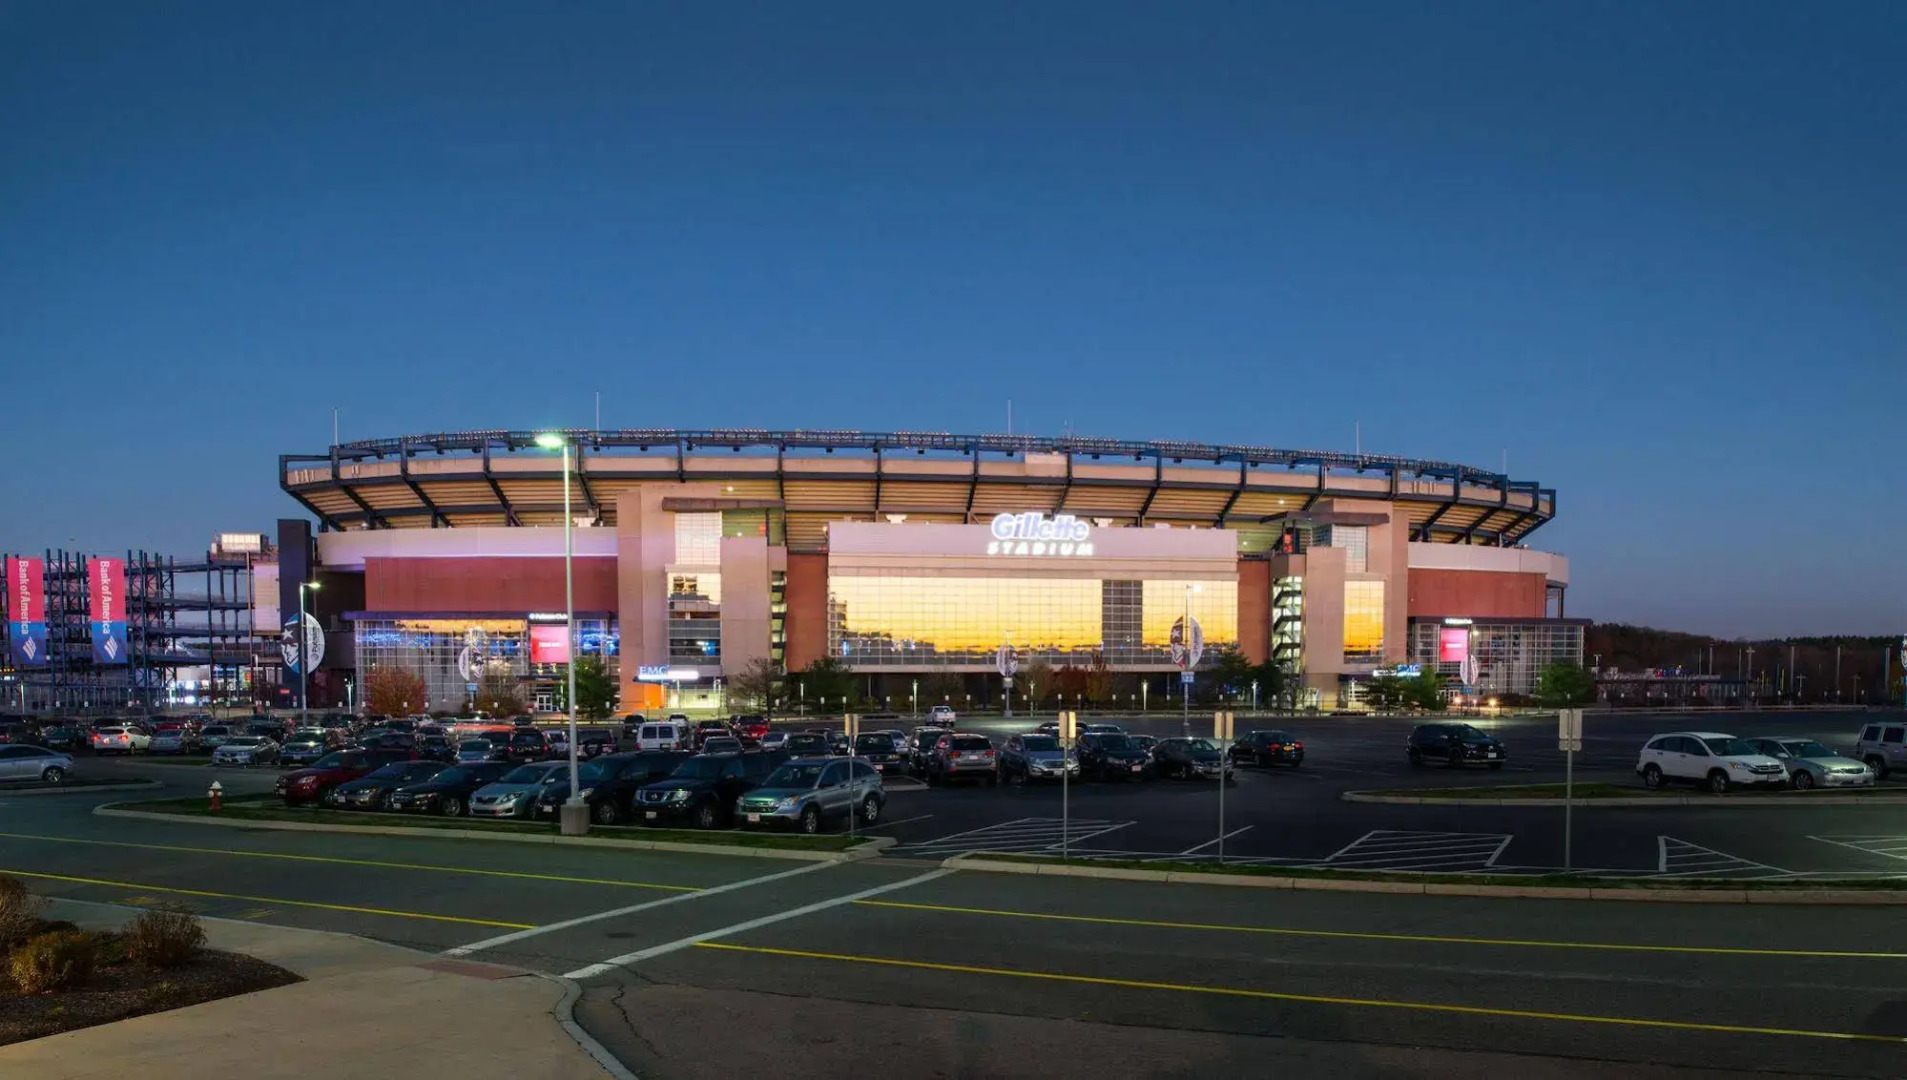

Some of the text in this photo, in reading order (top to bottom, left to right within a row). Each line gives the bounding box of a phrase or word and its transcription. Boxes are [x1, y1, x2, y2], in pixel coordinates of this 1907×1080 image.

[991, 512, 1089, 541] Gillette
[987, 541, 1093, 556] STADIUM
[18, 560, 30, 585] Bank
[100, 560, 112, 585] Bank
[20, 595, 32, 635] America
[102, 595, 113, 634] America
